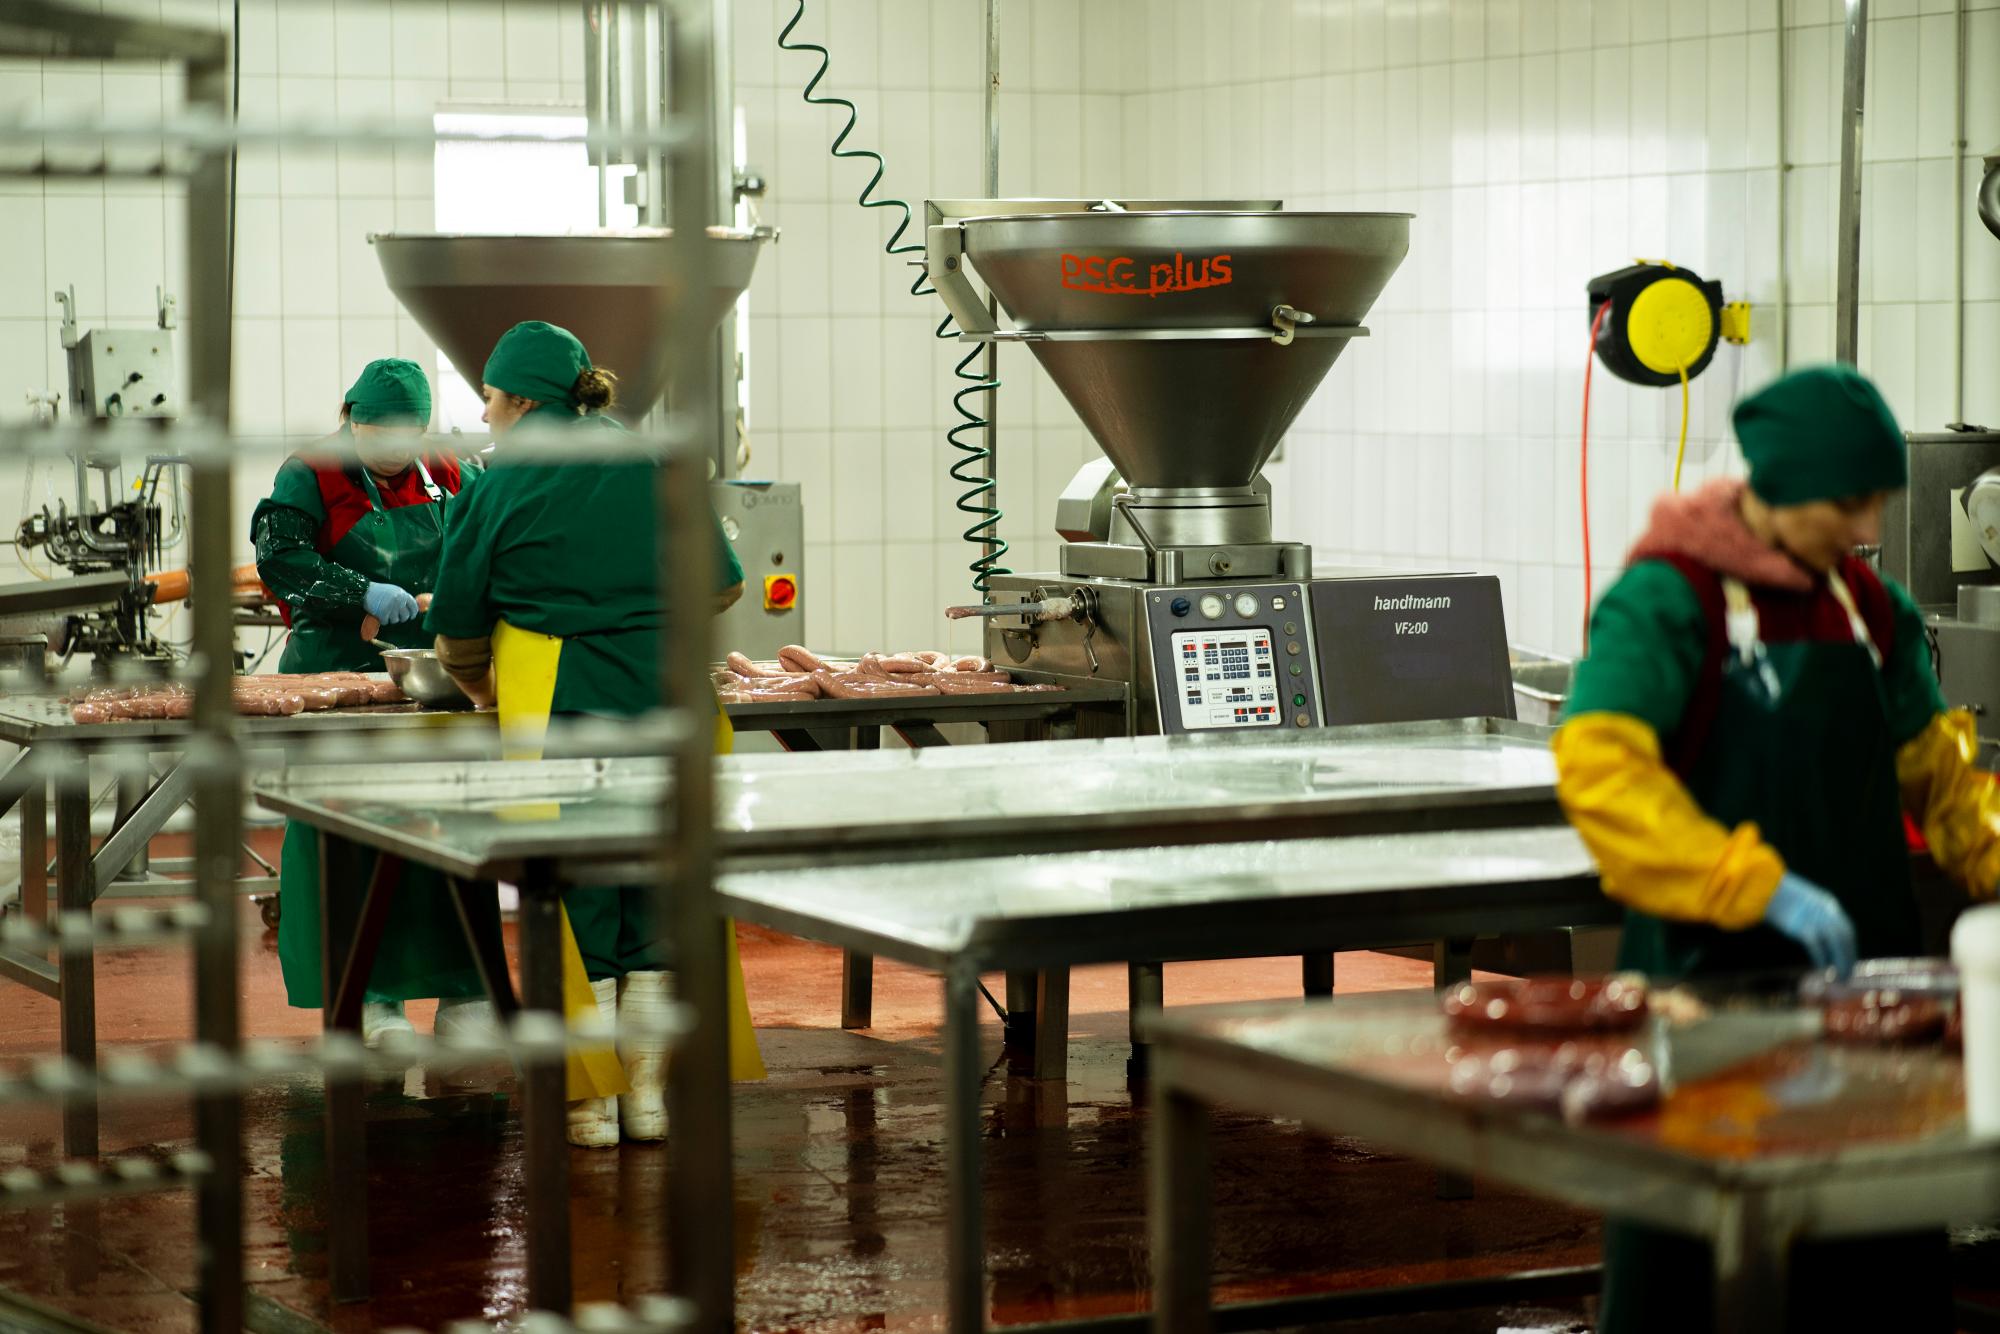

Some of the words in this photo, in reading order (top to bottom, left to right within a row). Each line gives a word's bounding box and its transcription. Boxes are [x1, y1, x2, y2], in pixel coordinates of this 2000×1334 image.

[1150, 252, 1232, 297] plus
[1374, 594, 1451, 611] handtmann
[1395, 621, 1429, 635] VF200
